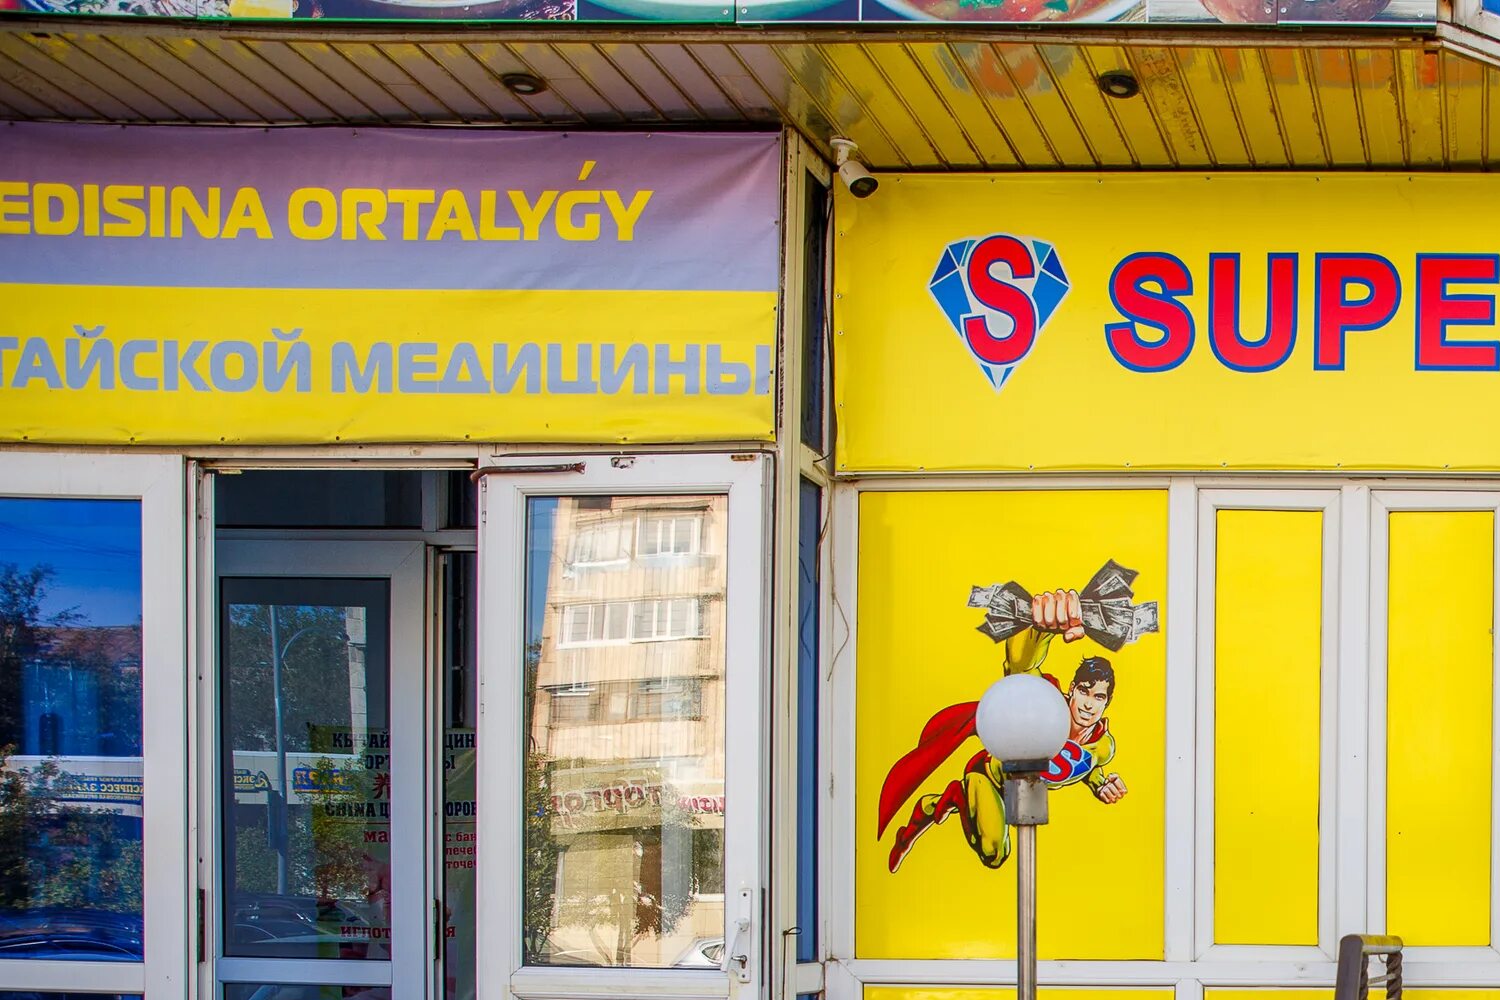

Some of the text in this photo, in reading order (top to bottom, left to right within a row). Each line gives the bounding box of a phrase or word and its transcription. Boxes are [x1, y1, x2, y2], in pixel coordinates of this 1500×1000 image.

[0, 181, 273, 240] EDISINA
[966, 235, 1035, 364] S
[0, 324, 771, 396] ТАЙСКОЙ МЕДИЦИНЫ
